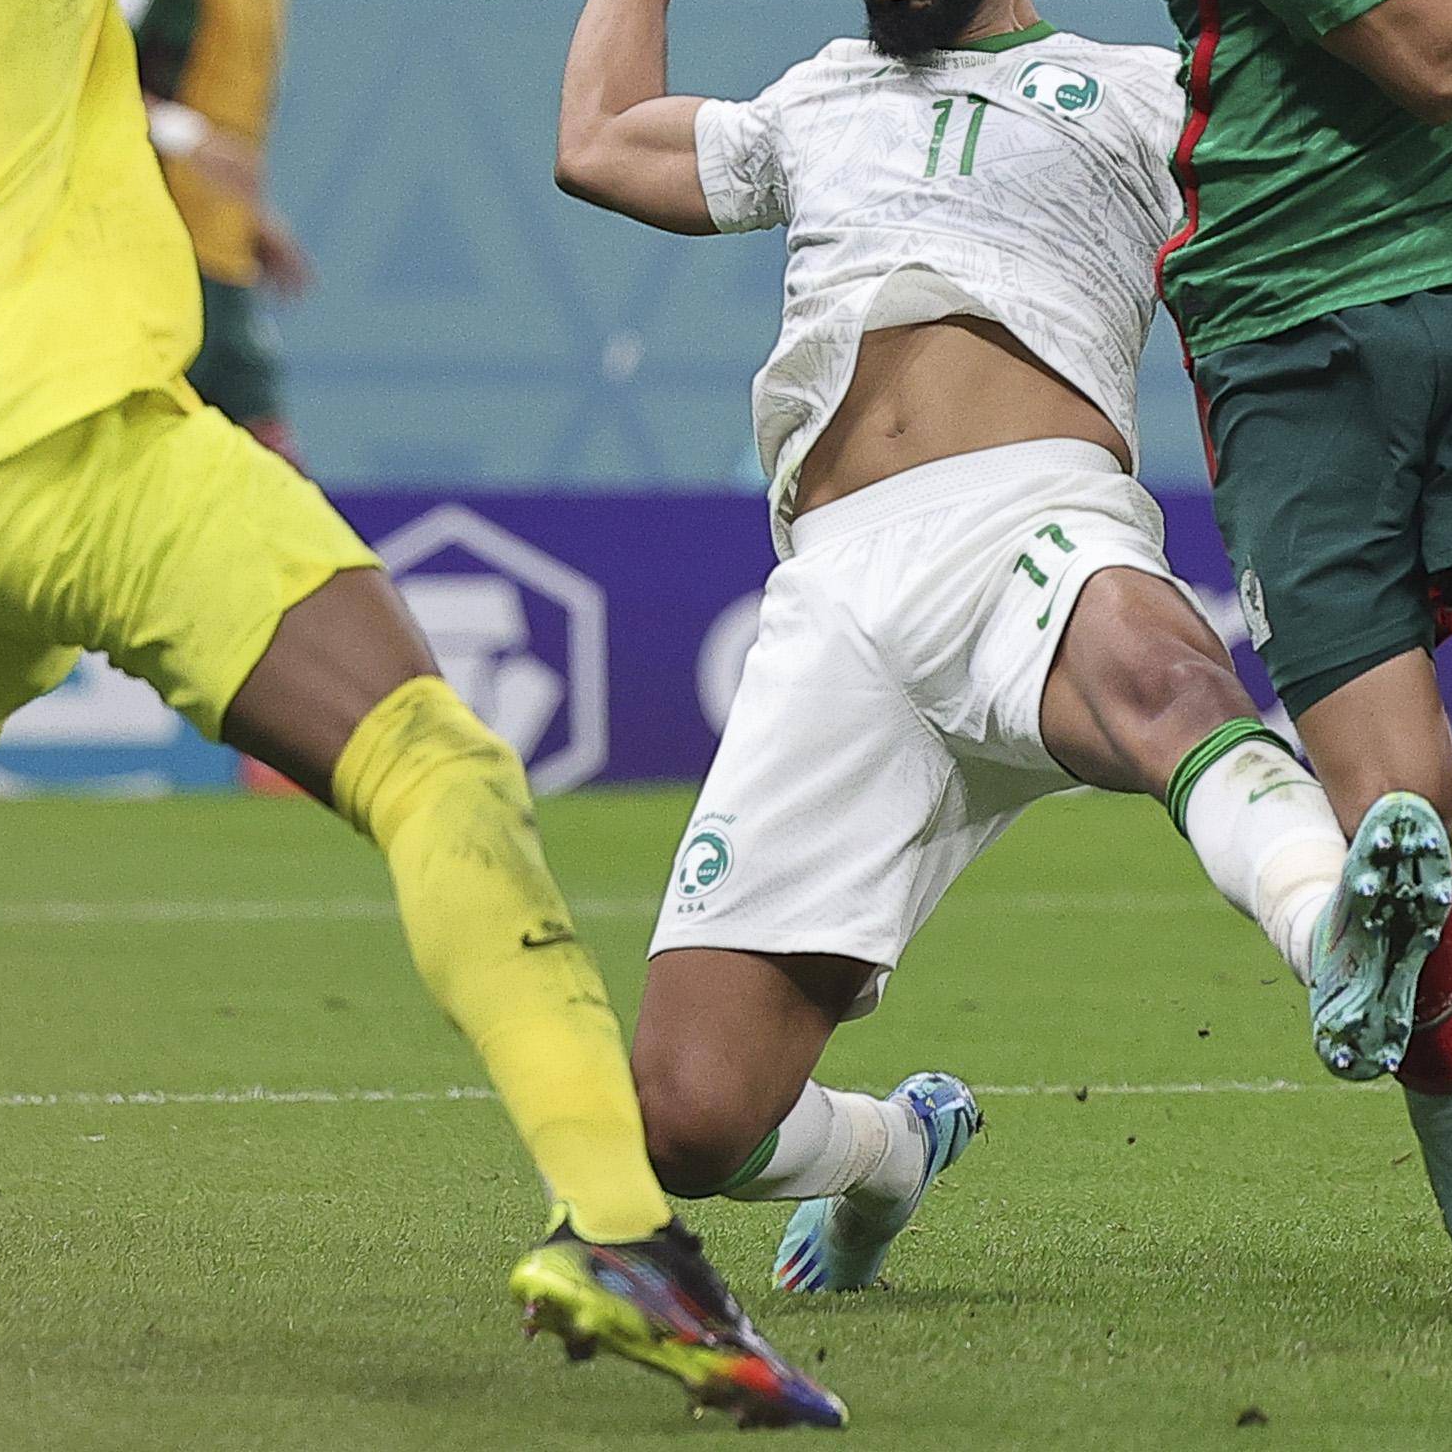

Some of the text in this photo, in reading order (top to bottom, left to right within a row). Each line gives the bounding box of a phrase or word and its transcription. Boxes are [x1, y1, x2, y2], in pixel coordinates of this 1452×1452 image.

[923, 94, 988, 178] 11
[1012, 522, 1078, 589] 11
[677, 901, 706, 914] KSA
